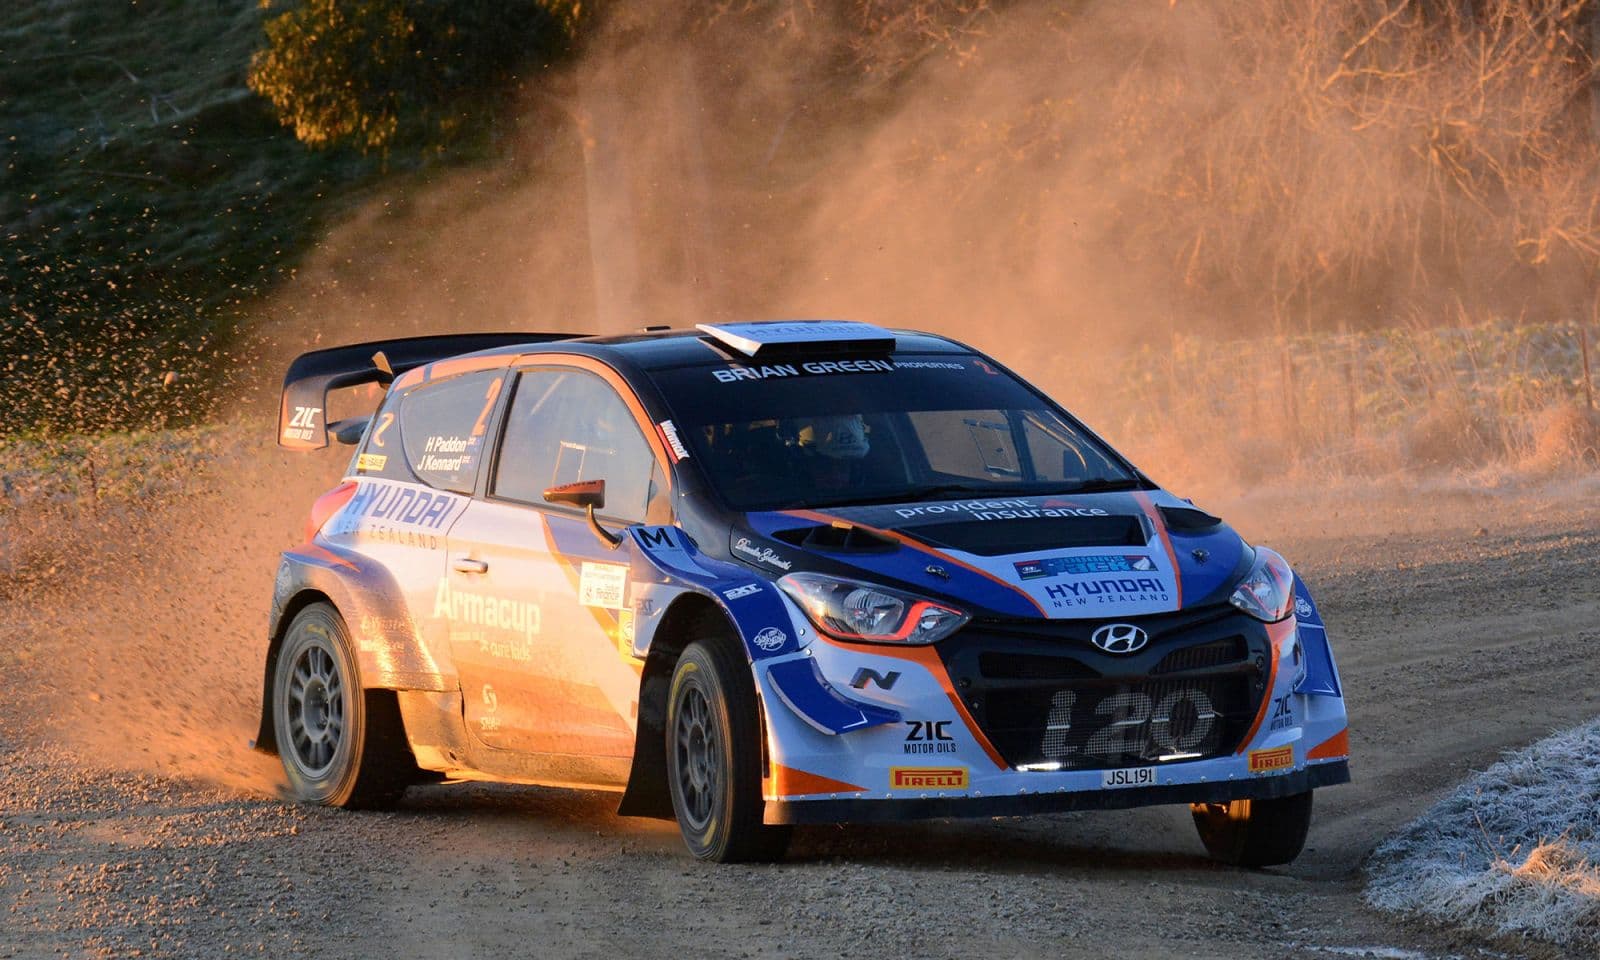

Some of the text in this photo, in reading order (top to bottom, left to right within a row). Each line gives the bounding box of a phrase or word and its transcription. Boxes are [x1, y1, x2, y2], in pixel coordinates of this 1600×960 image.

[712, 359, 965, 383] BRIAN GREEN PROPERTIES
[974, 360, 999, 375] 2
[289, 406, 322, 428] ZIC
[471, 377, 502, 437] 2
[373, 412, 394, 448] 2
[425, 436, 467, 452] H Paddon
[417, 455, 463, 470] J Kennard
[344, 482, 458, 528] HYUNDAI
[894, 499, 1037, 520] provident
[969, 507, 1109, 521] insurance
[370, 524, 437, 550] ZEALAND
[637, 527, 675, 548] M
[1044, 578, 1165, 599] HYUNDAI
[432, 577, 541, 646] Armacup
[1053, 594, 1169, 608] NEW ZEALAND
[848, 667, 902, 690] N
[1274, 695, 1292, 718] ZIC
[905, 721, 954, 741] ZIC
[903, 743, 957, 754] MOTOR OILS
[1251, 748, 1292, 769] PIRELLI
[894, 770, 963, 786] PIRELLI
[1107, 768, 1153, 786] JSL191
